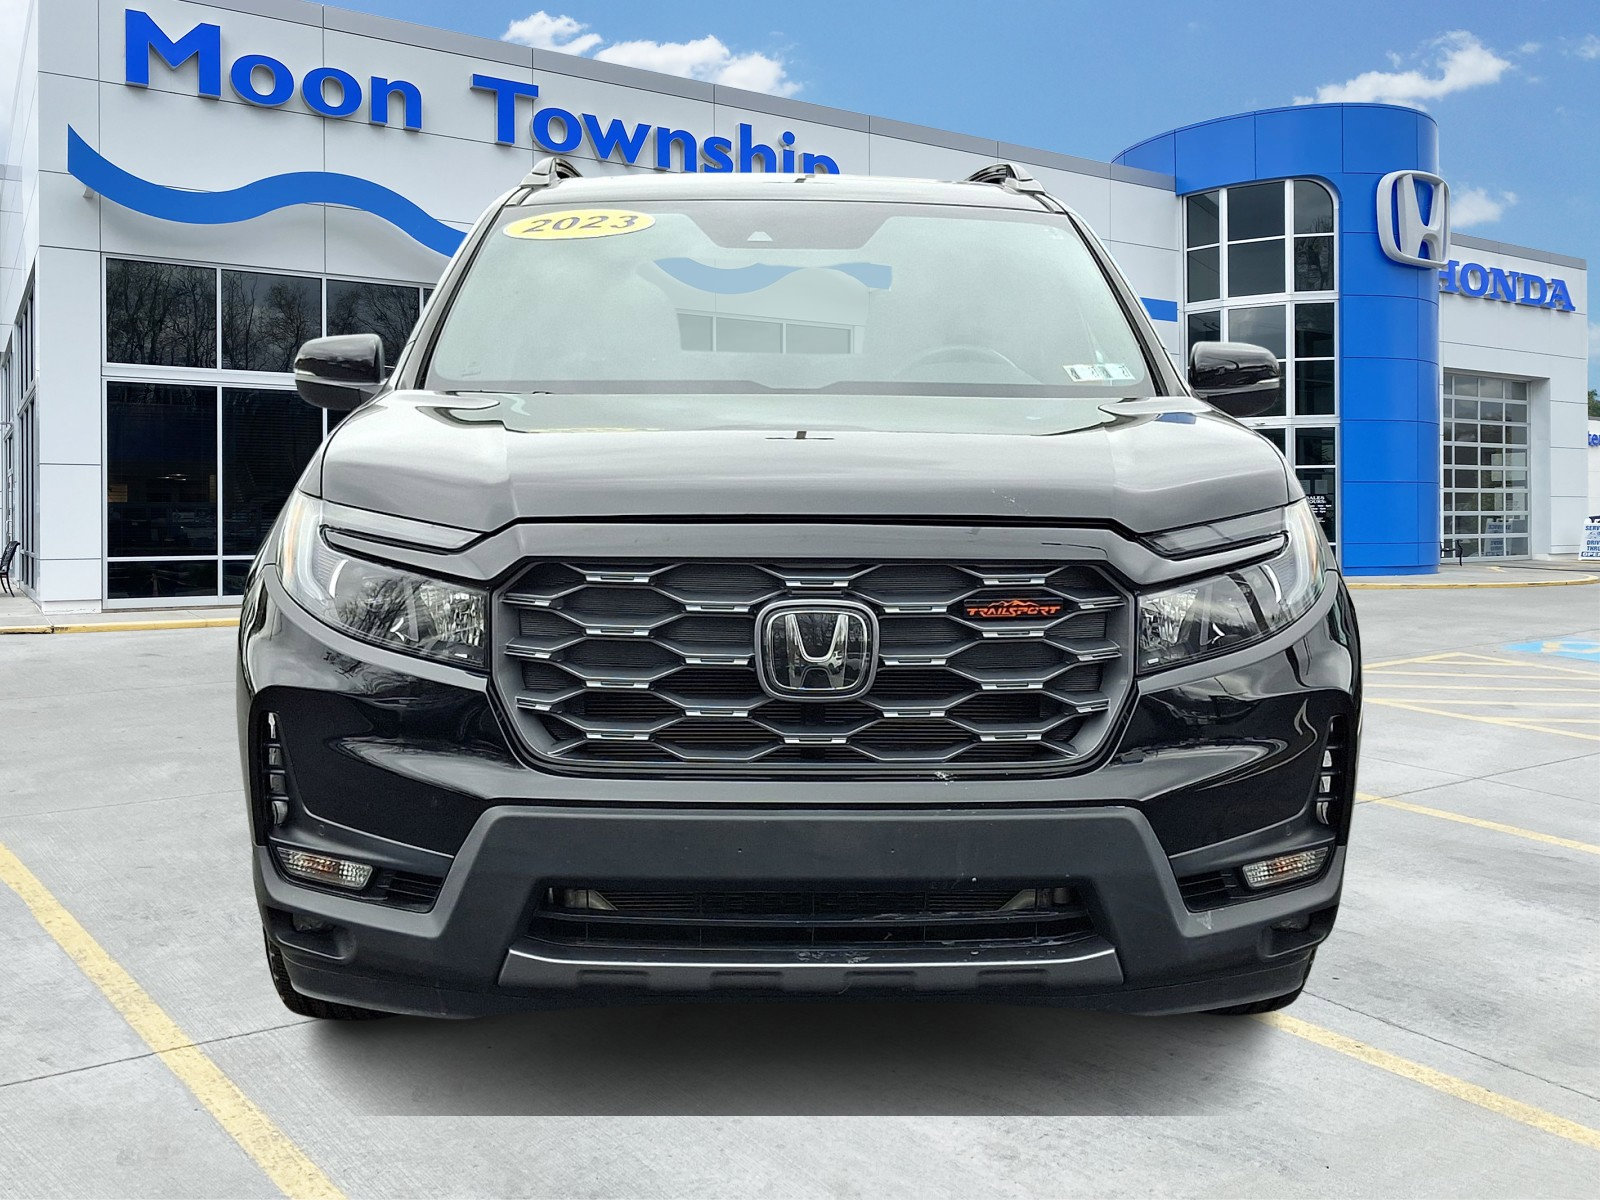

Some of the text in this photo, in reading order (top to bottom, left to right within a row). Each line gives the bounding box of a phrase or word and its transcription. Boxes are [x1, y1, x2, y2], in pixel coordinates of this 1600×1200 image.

[125, 8, 422, 131] Moon
[522, 215, 639, 234] 2023
[1438, 259, 1577, 312] HONDA
[966, 606, 1061, 618] TRAILSPORT
